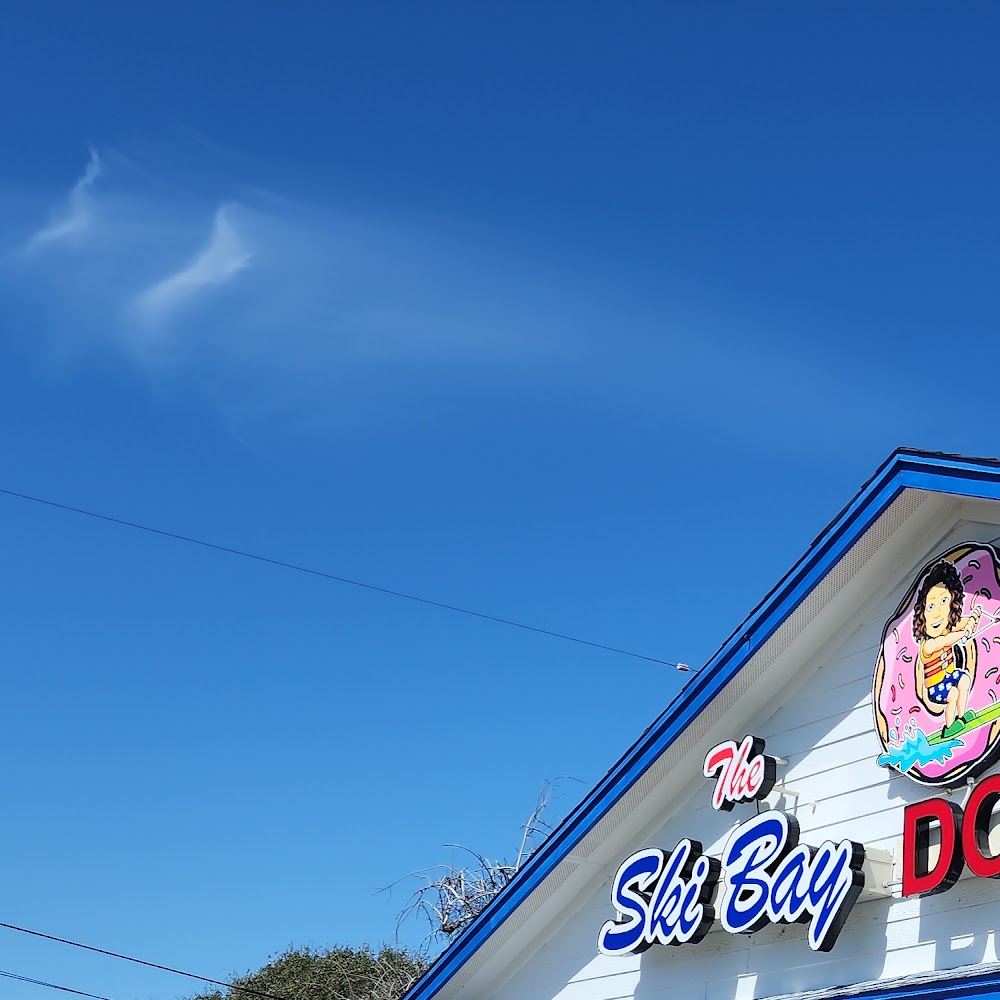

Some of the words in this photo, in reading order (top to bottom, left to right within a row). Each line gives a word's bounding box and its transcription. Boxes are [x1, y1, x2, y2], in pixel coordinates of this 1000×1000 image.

[704, 736, 765, 809] The
[599, 838, 711, 954] Ski
[721, 810, 853, 950] Bay
